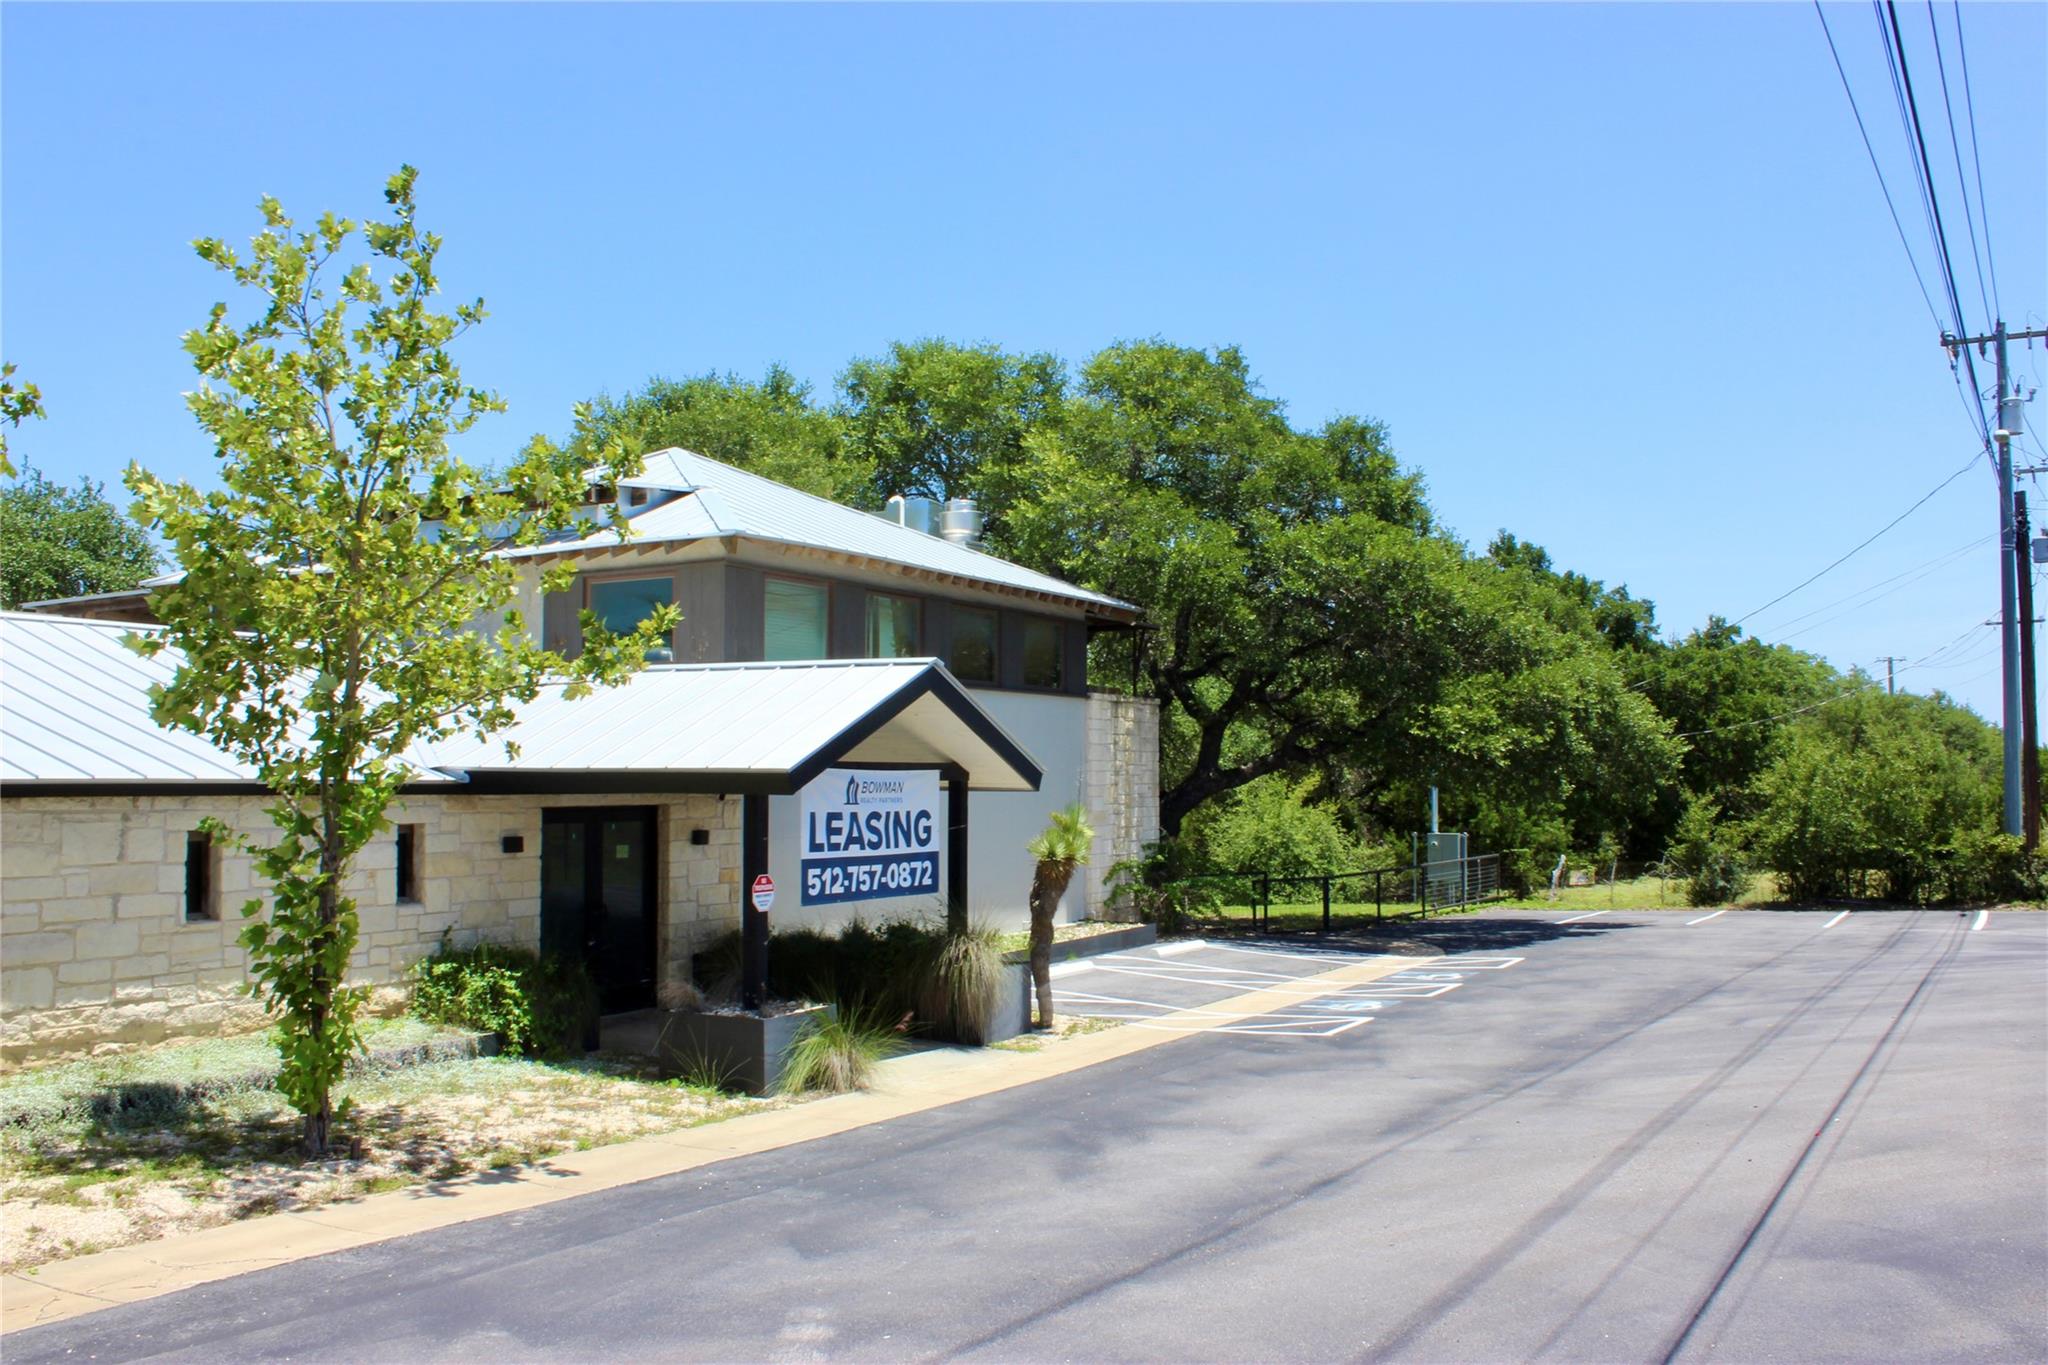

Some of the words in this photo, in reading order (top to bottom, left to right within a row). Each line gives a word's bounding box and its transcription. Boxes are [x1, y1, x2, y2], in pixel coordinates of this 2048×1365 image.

[861, 781, 904, 793] BOWMAN
[809, 810, 932, 853] LEASING
[807, 860, 933, 896] 512-757-0872
